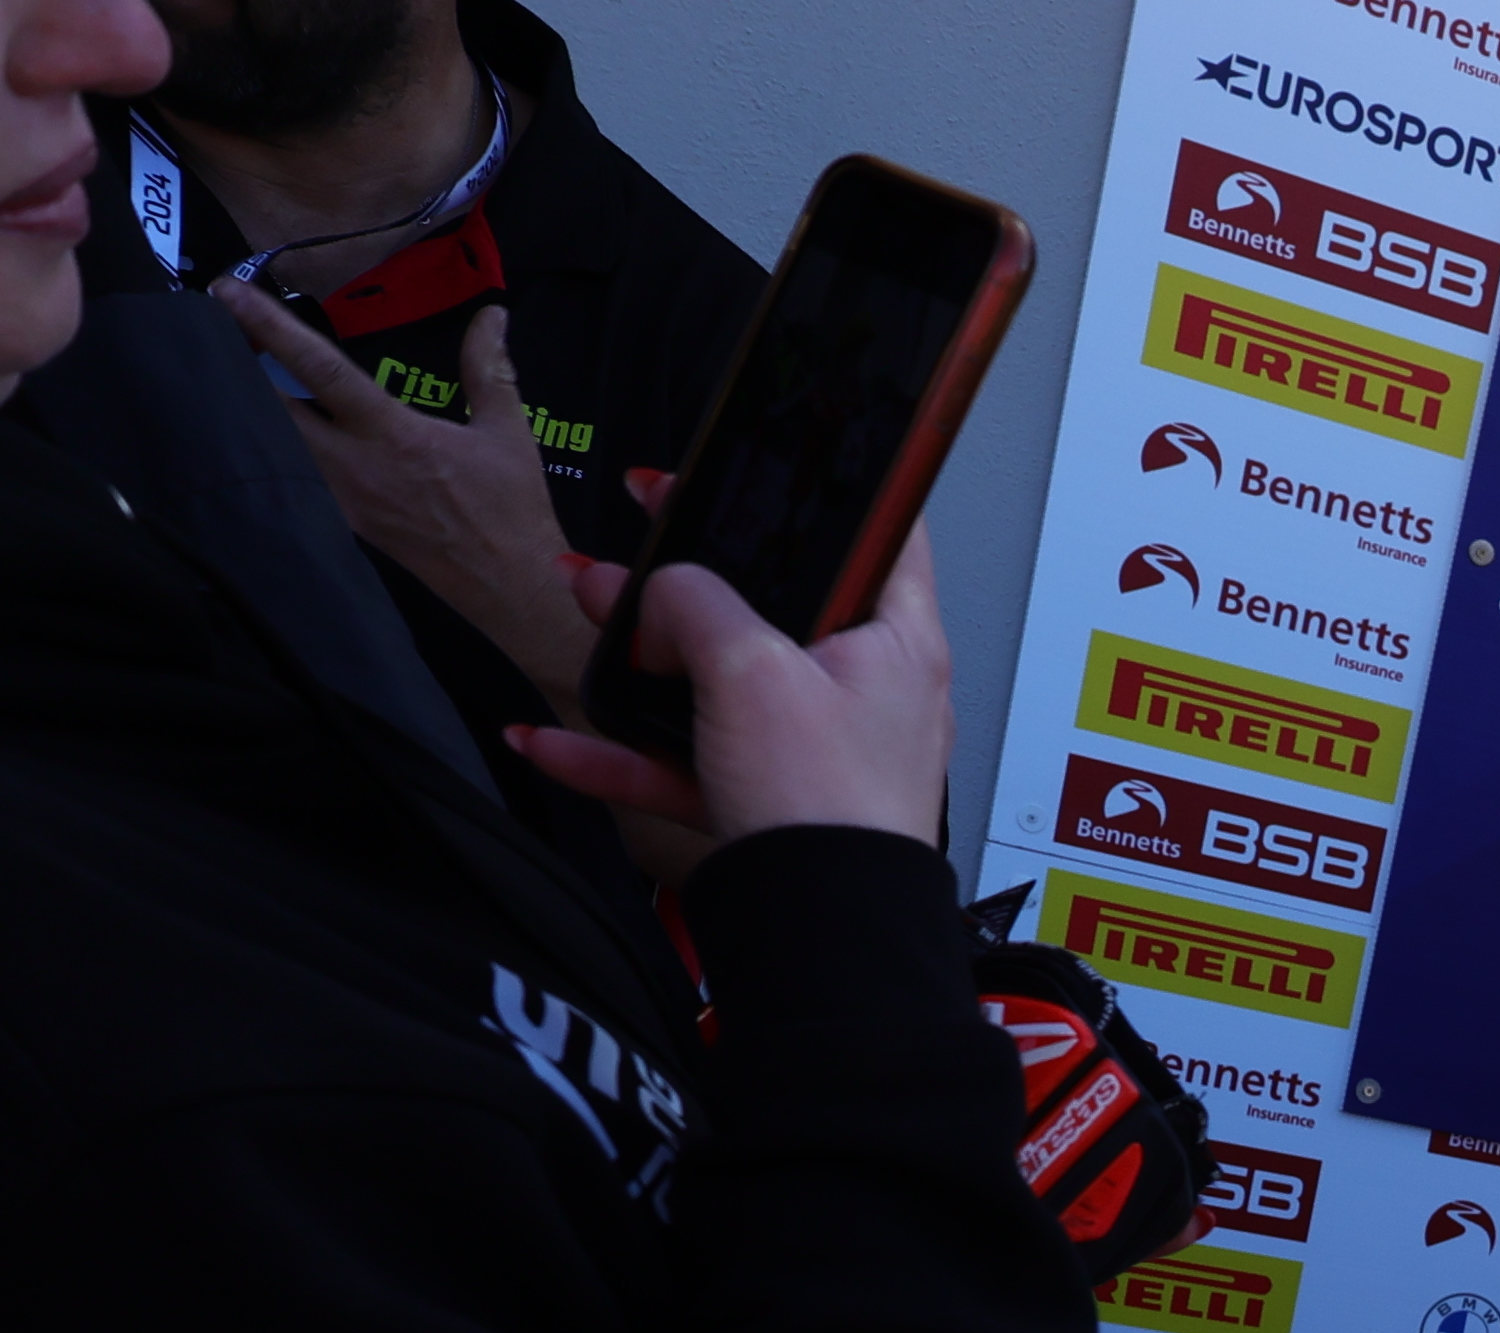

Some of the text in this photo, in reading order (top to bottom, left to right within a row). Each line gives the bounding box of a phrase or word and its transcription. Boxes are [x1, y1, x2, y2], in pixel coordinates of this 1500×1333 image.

[144, 171, 171, 234] 2024
[1188, 208, 1488, 308] Bennetts BSB
[376, 356, 459, 408] City
[1174, 293, 1451, 431] PIRELLI
[1240, 459, 1433, 544] Bennetts
[1357, 536, 1427, 568] Insurance
[1217, 578, 1410, 661] Bennetts
[1334, 652, 1404, 684] Insurance
[1108, 658, 1380, 777] PIRELLI
[1076, 808, 1369, 890] Bennetts BSB
[1065, 895, 1334, 1003] PIRELLI
[1143, 1042, 1321, 1108] ennetts
[1247, 1104, 1315, 1128] Insurance
[1199, 1163, 1304, 1222] SB
[1438, 1297, 1498, 1327] BMW
